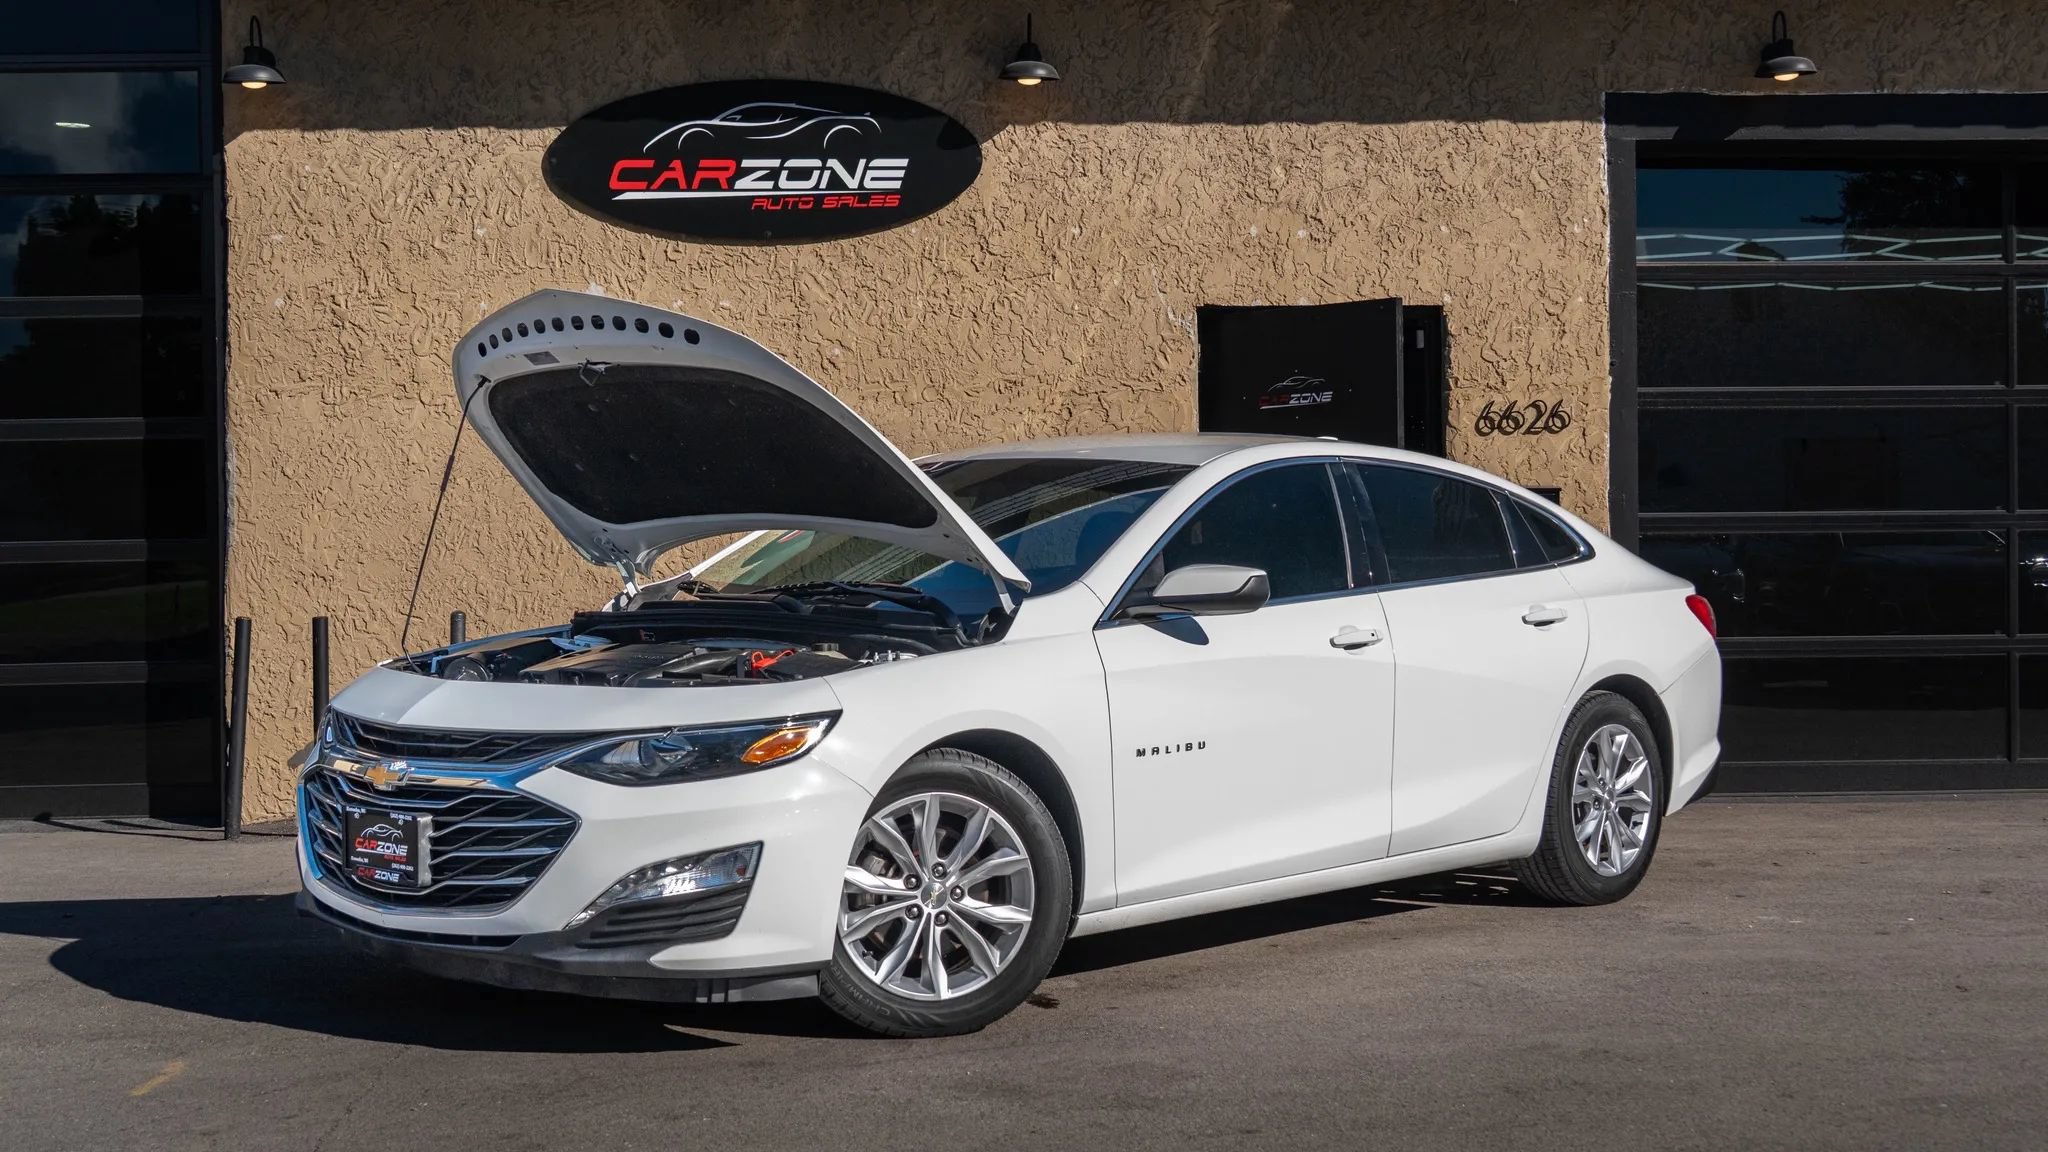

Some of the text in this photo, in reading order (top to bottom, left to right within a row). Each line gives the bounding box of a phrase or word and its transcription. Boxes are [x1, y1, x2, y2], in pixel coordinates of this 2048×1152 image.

[609, 158, 910, 190] CARZONE
[751, 194, 901, 211] AUTO SALES
[1474, 399, 1571, 437] 6626
[1136, 741, 1205, 757] MALIBU
[355, 838, 408, 856] CARZONE
[357, 866, 400, 882] CARZONE
